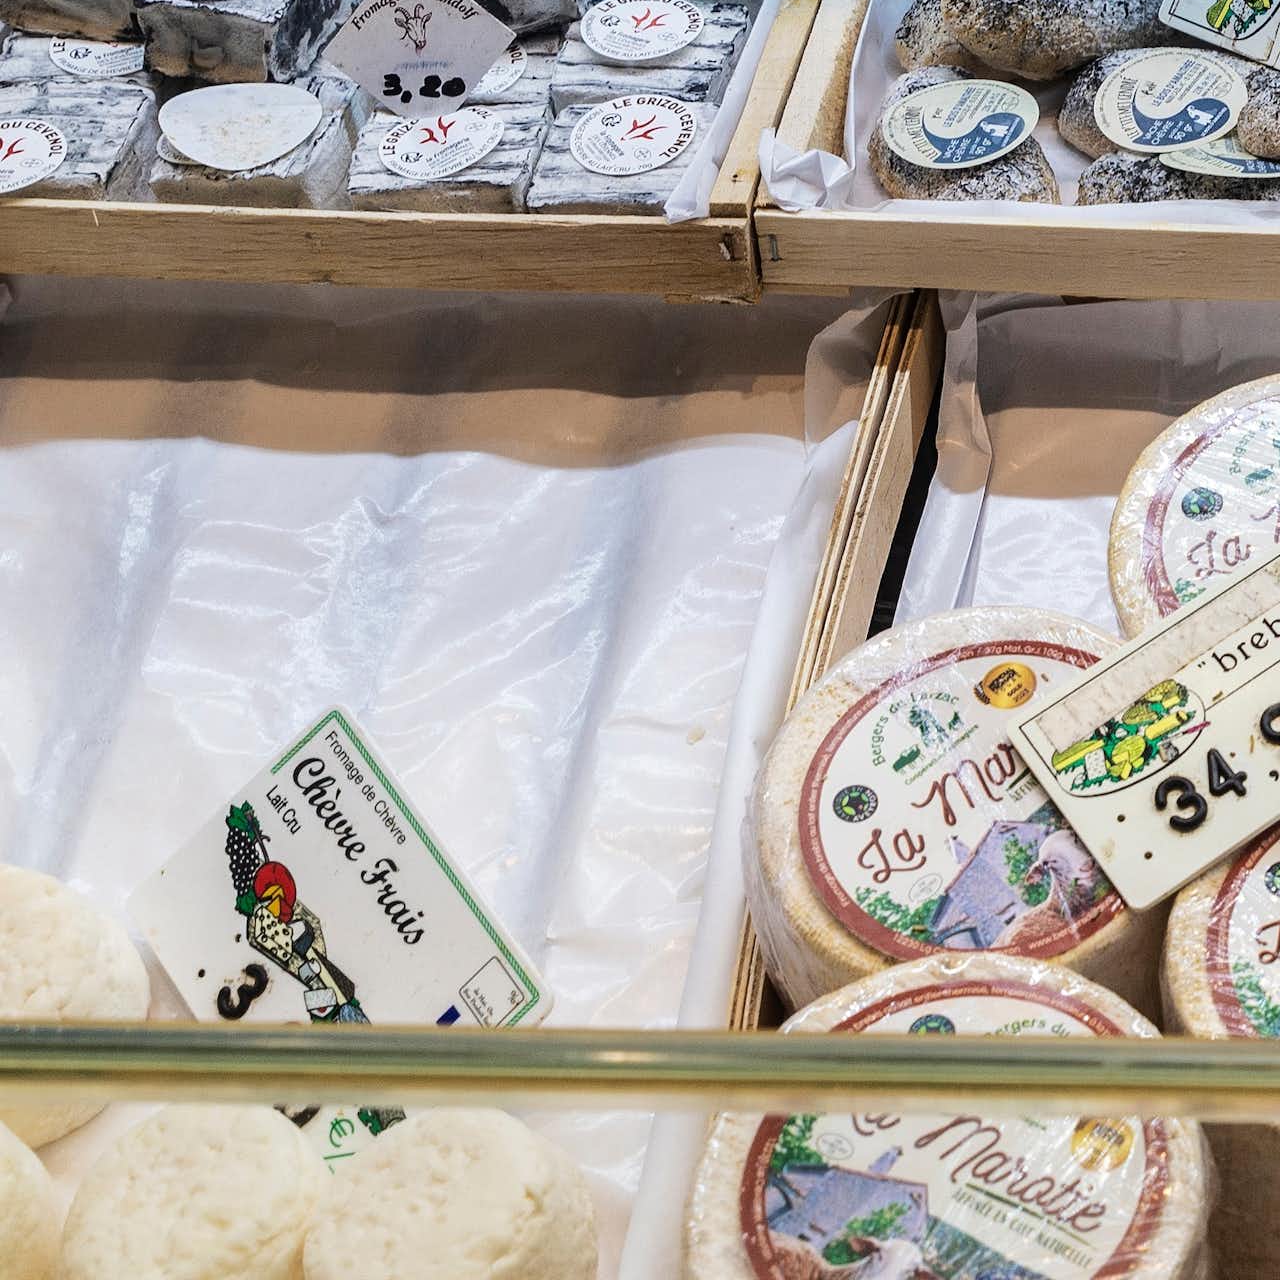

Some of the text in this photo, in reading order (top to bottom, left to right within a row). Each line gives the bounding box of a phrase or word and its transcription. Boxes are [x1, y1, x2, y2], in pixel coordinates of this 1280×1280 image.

[597, 2, 617, 13] LE
[673, 0, 701, 34] CEVENOL
[52, 40, 65, 53] LE
[382, 73, 466, 104] 3,20
[24, 121, 63, 158] CEVENOL
[383, 145, 395, 156] LE
[612, 97, 694, 159] LE GRIZOU CEVENOL
[1186, 529, 1252, 580] La
[872, 712, 890, 767] Bergers
[266, 784, 302, 836] Lait Cru
[324, 730, 408, 846] Fromage de Chèvre
[292, 756, 425, 945] Chèvre Frais
[857, 828, 927, 884] La
[914, 1116, 1111, 1234] Marotte
[1033, 1228, 1095, 1270] NATURELLE
